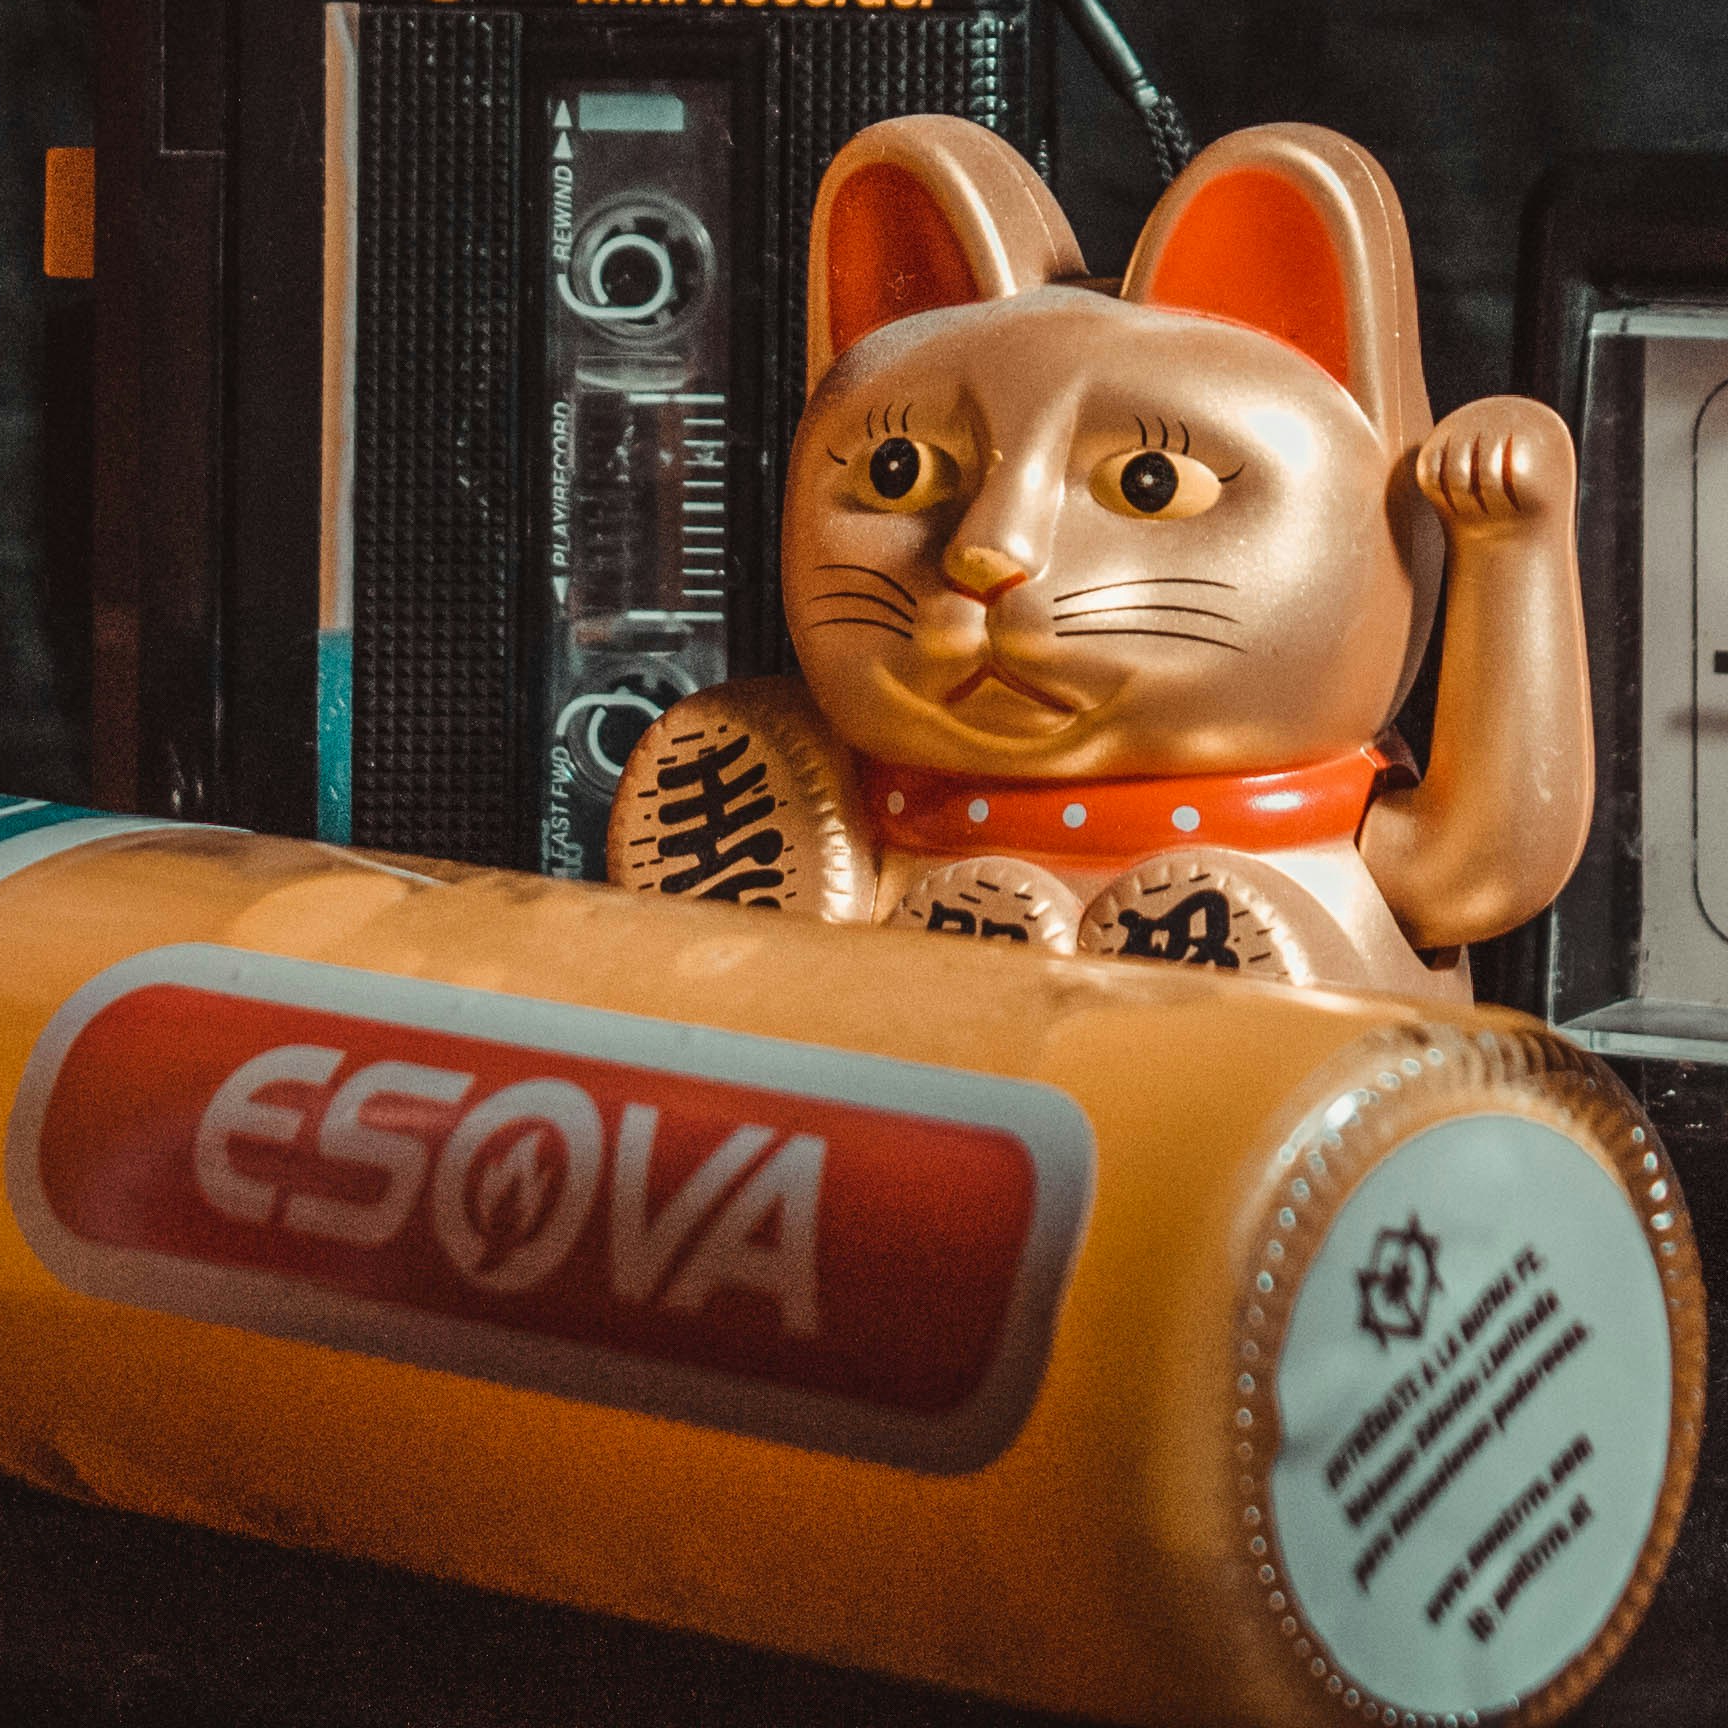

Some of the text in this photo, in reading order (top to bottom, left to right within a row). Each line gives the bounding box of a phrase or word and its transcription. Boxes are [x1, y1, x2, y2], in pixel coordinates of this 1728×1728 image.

[553, 165, 572, 261] REWIND
[552, 400, 573, 568] PLAY/RECORD
[551, 745, 574, 860] FAST FWD
[194, 1042, 828, 1339] ESOVA
